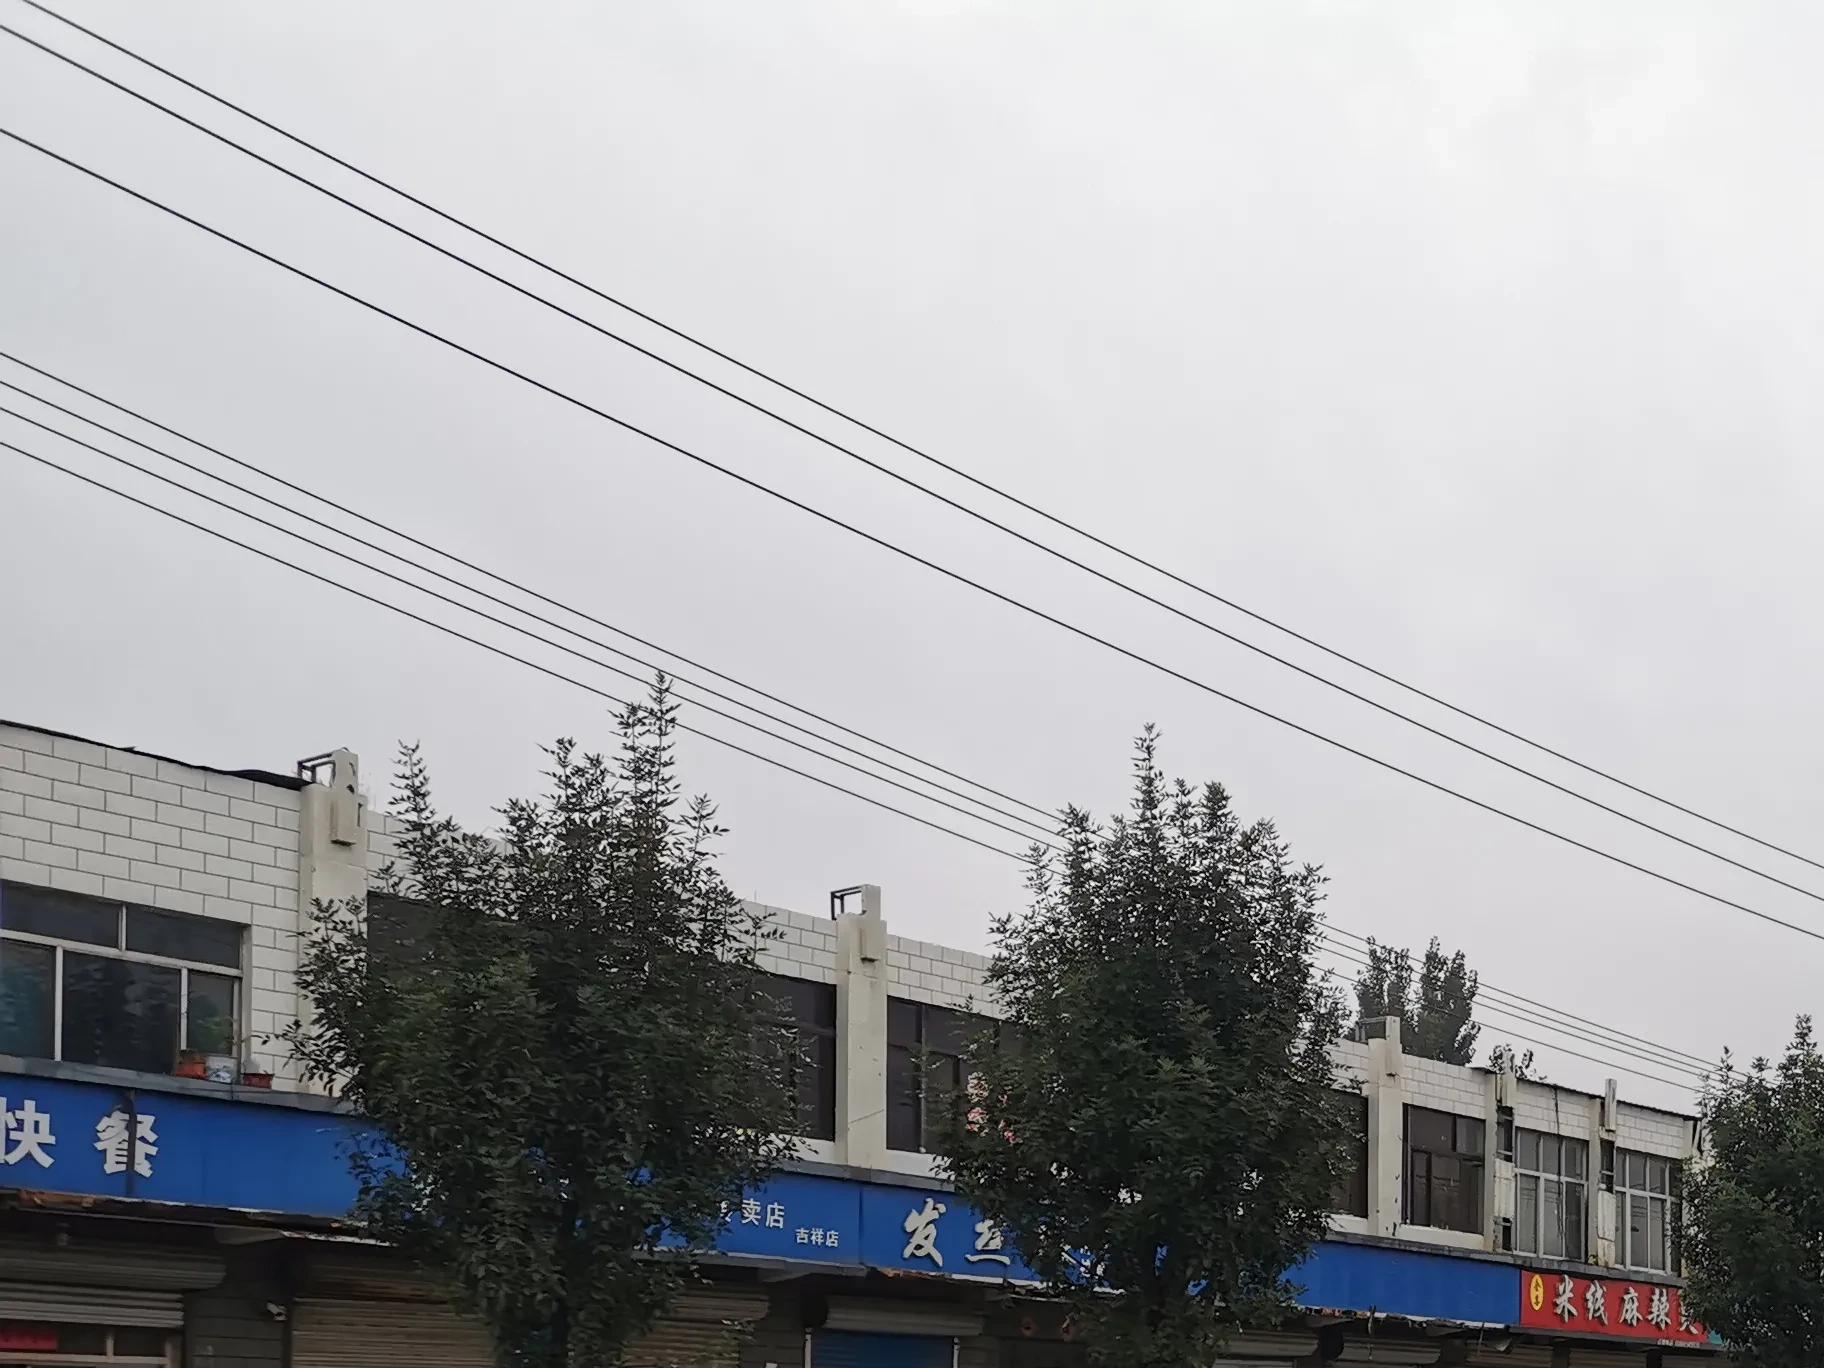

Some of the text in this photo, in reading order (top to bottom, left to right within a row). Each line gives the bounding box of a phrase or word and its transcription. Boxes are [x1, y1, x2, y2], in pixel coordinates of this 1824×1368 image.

[0, 1097, 160, 1178] 快餐
[795, 1227, 840, 1248] 吉祥店
